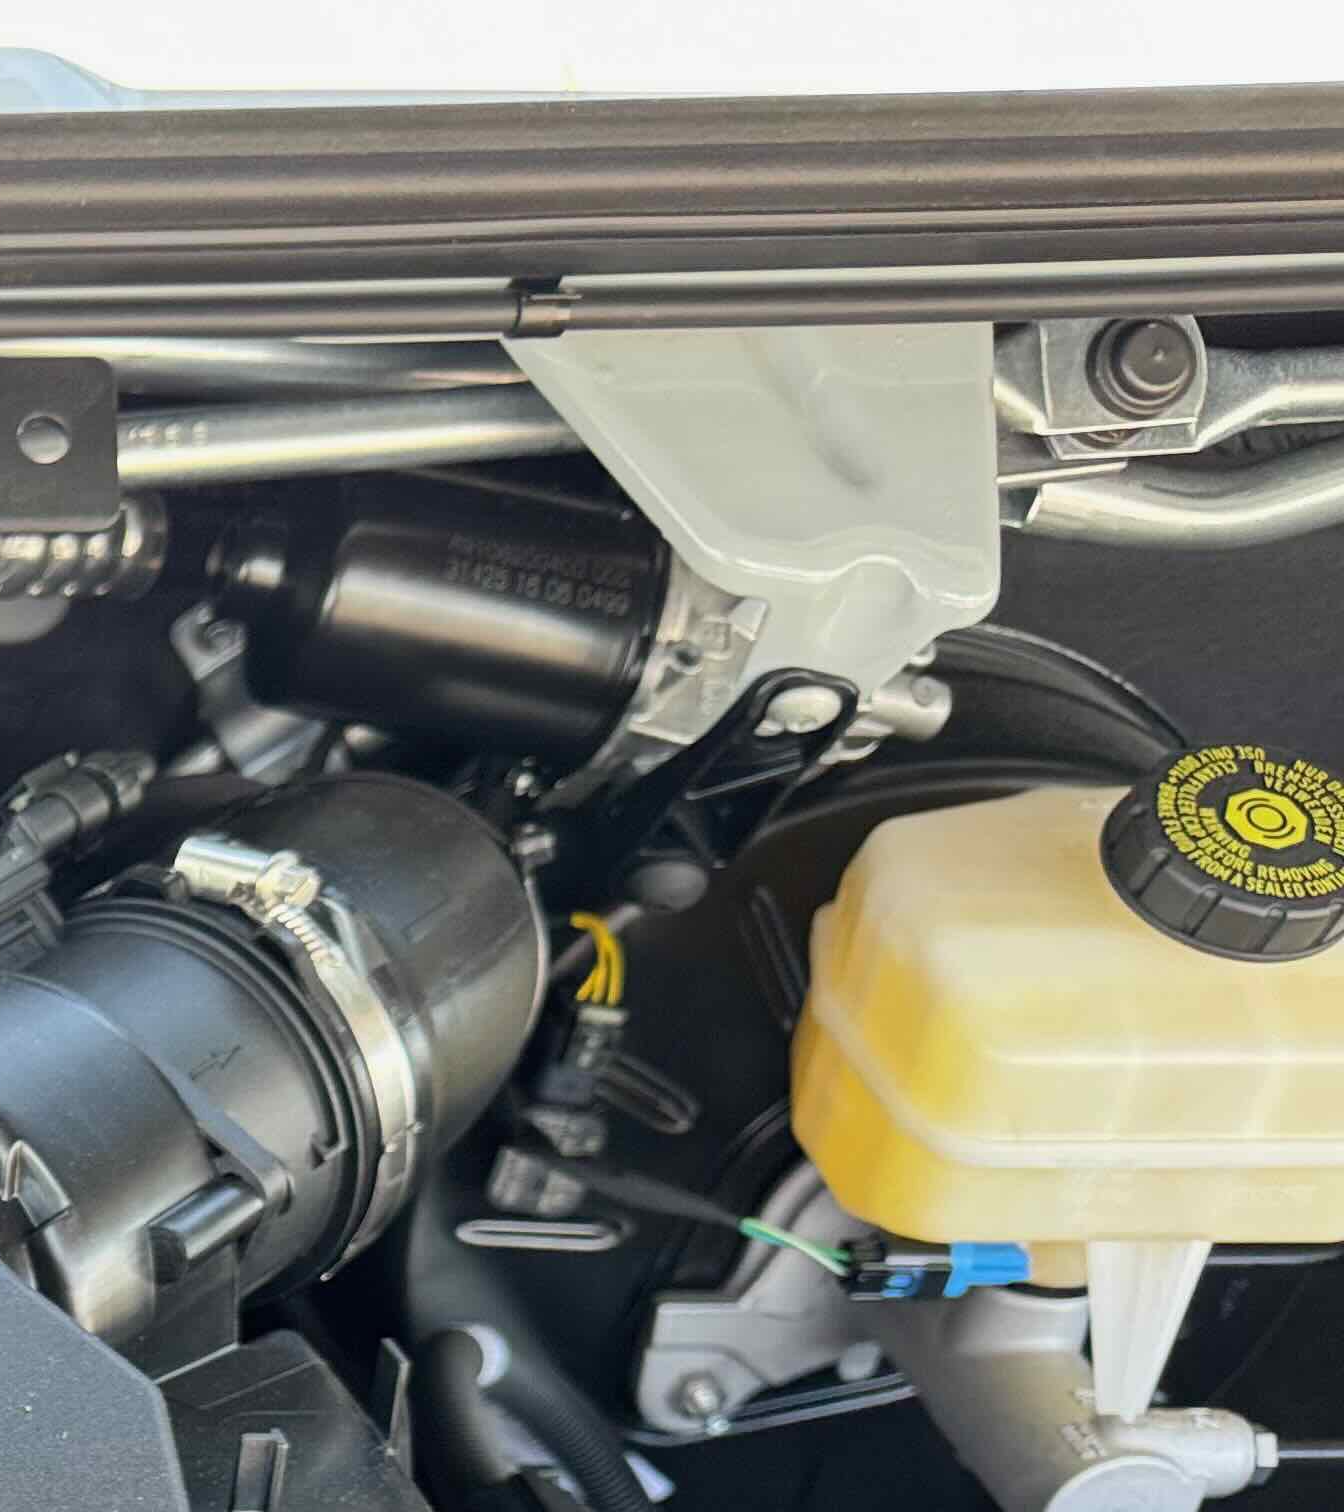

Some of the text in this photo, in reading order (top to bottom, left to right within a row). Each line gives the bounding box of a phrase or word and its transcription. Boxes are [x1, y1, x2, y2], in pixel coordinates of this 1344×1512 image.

[1197, 745, 1234, 763] ONLY
[1235, 745, 1265, 760] USE
[1293, 760, 1329, 784] NUR
[1186, 849, 1233, 881] FROM
[1196, 836, 1255, 876] BEFORE
[1257, 857, 1336, 882] REMOVING
[1230, 872, 1243, 887] A
[1245, 876, 1307, 898] SEALED
